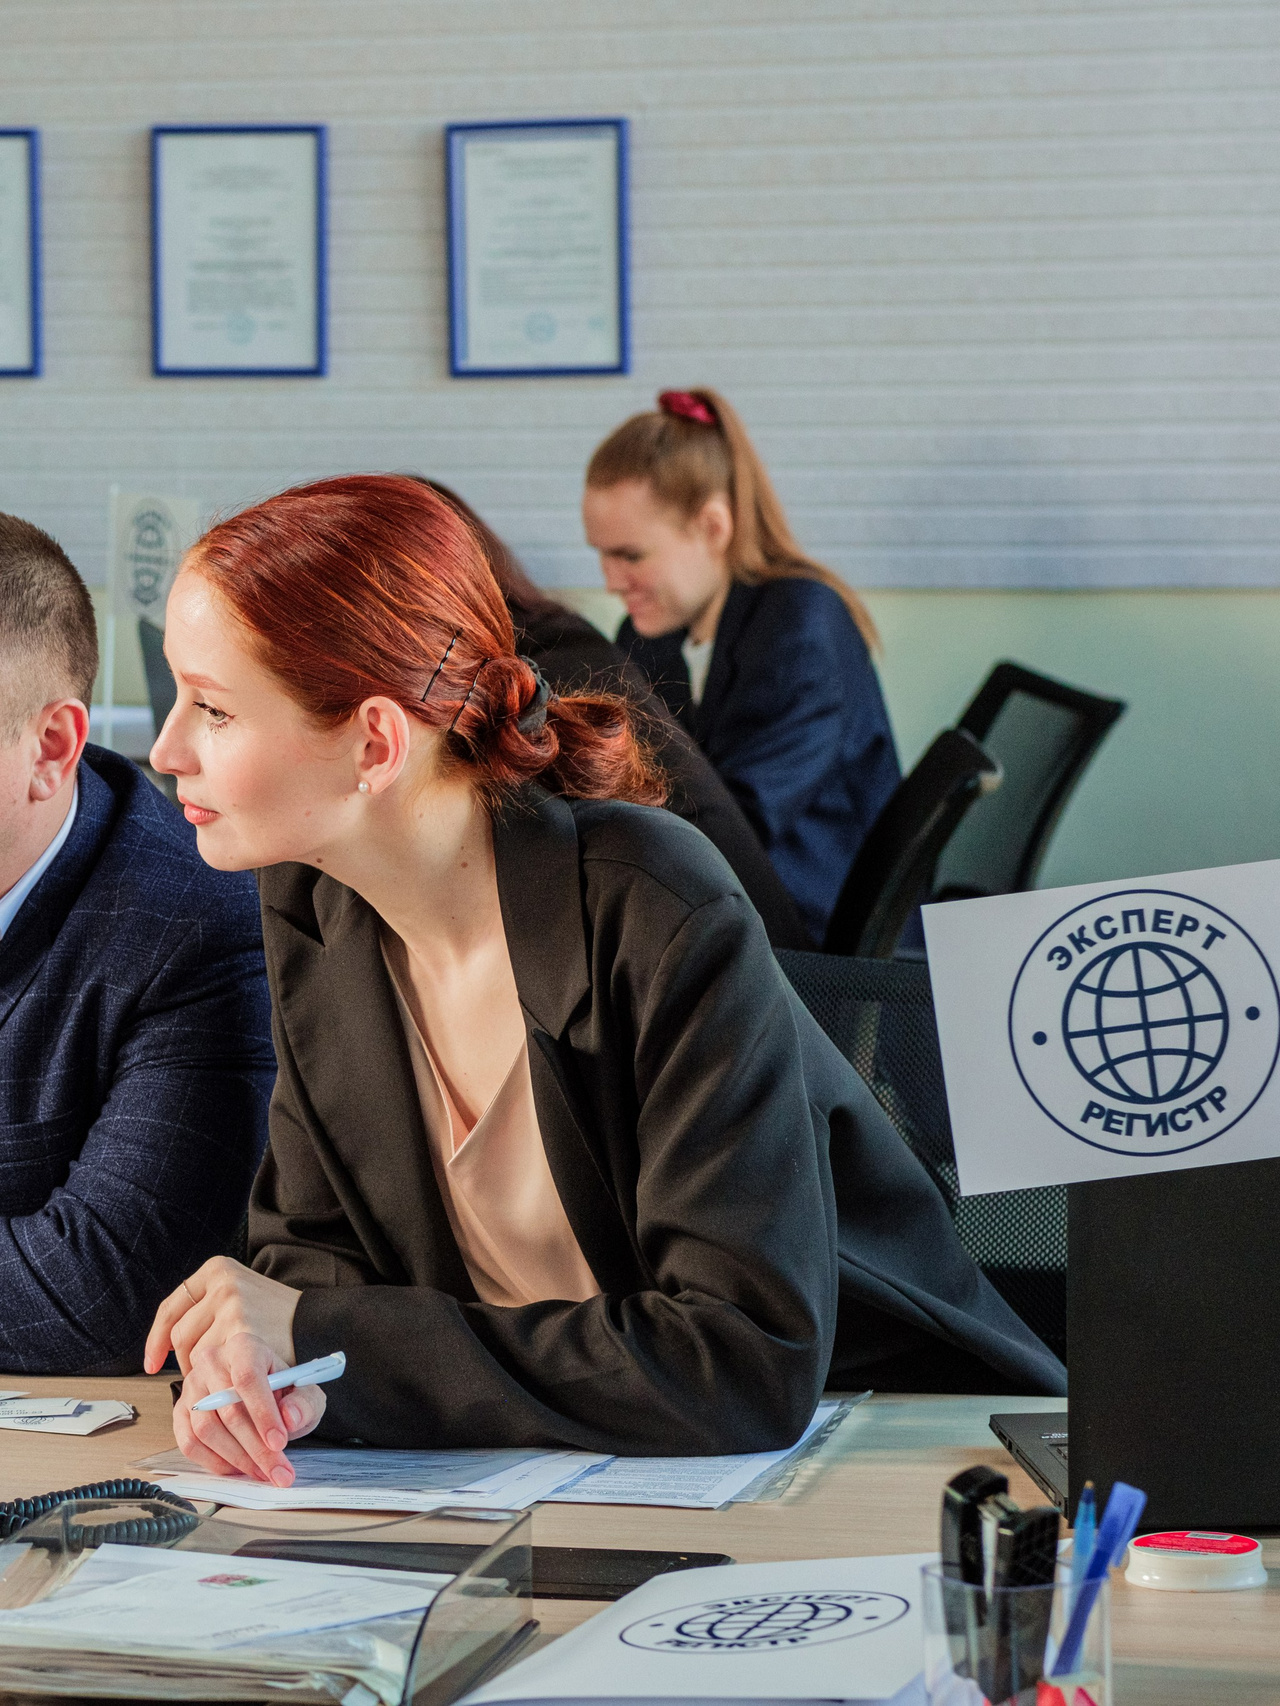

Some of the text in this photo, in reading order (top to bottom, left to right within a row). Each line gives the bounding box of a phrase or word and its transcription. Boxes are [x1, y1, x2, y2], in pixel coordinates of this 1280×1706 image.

[1046, 908, 1228, 972] ЭКСПЕРТ
[1079, 1084, 1228, 1138] РЕГИСТР
[703, 1593, 881, 1611] ЭКСПЕРТ
[655, 1636, 809, 1649] РЕГИСТР
